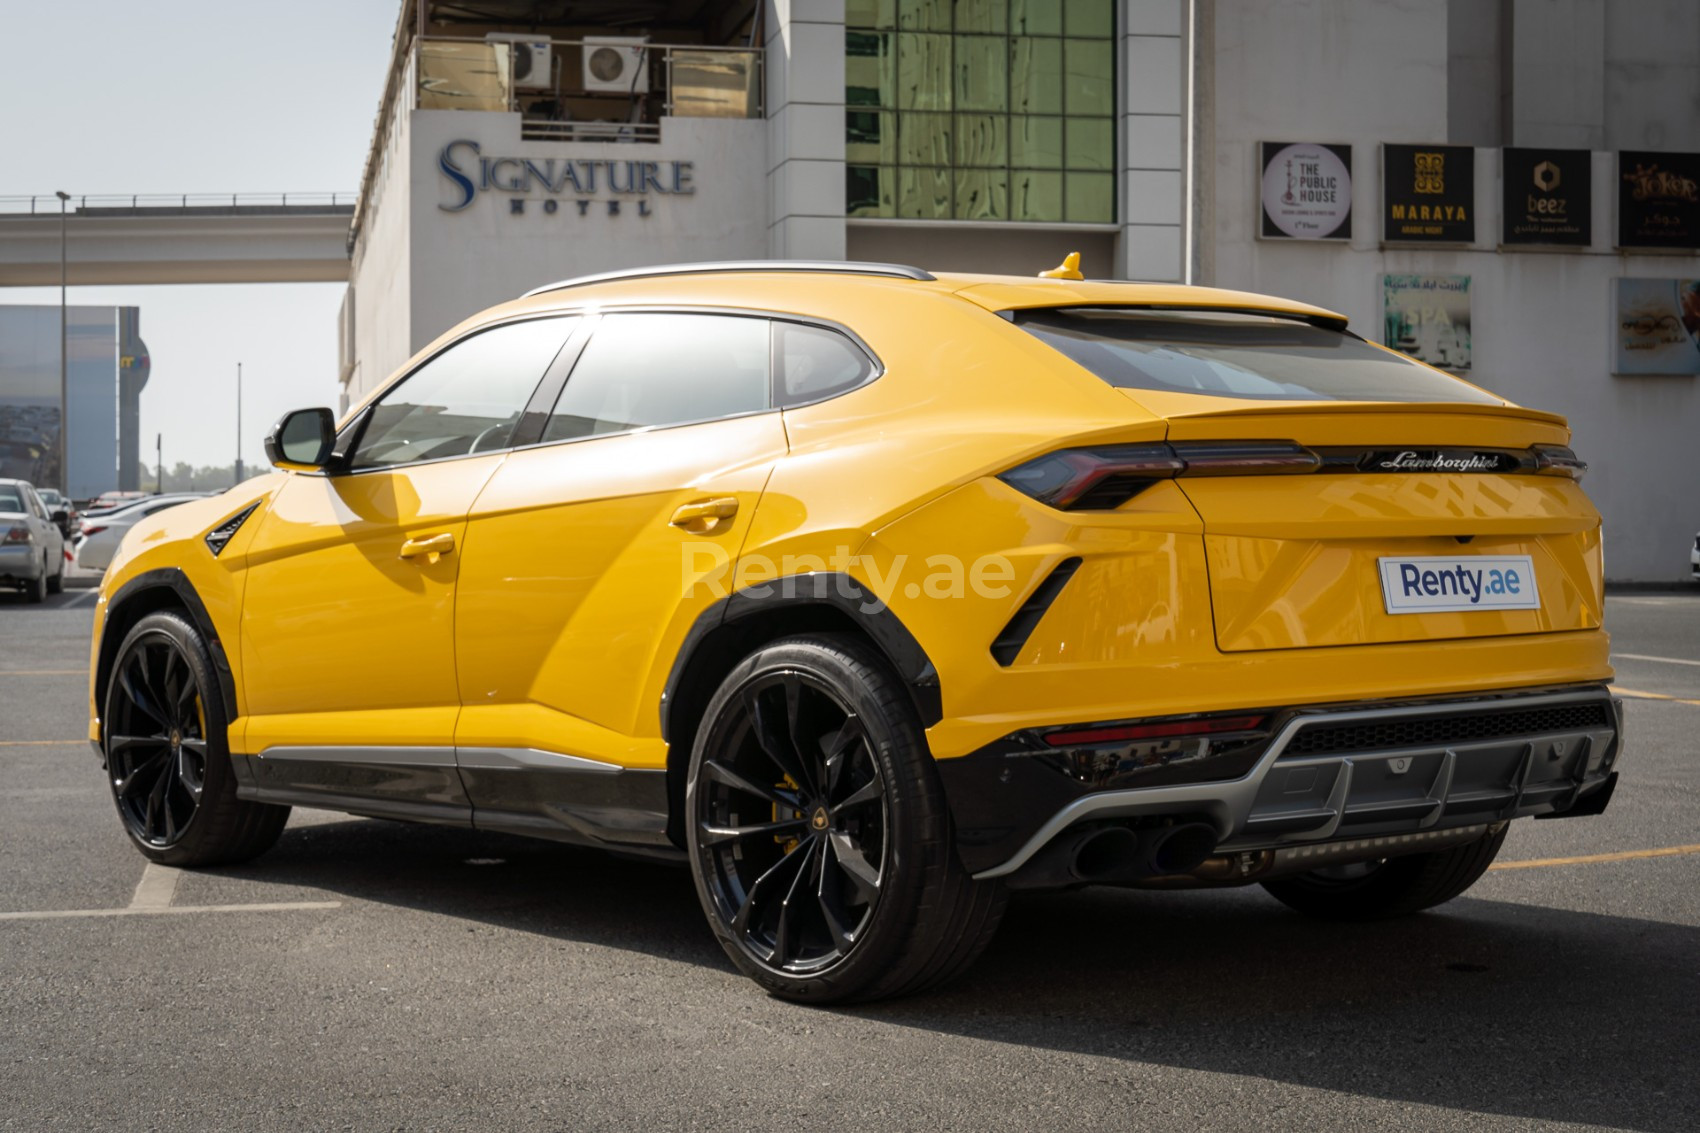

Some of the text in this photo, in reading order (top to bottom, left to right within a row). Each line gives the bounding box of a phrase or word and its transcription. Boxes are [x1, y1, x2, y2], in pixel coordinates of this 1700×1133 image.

[438, 139, 695, 213] SIGNATURE
[1300, 163, 1319, 175] THE
[1300, 177, 1336, 189] PUBLIC
[1300, 190, 1336, 203] HOUSE
[1528, 194, 1566, 213] beez
[510, 199, 651, 216] HOTEL
[1392, 205, 1466, 220] MARAYA
[1381, 451, 1498, 471] Lamborghini
[1400, 563, 1520, 604] Renty.ae
